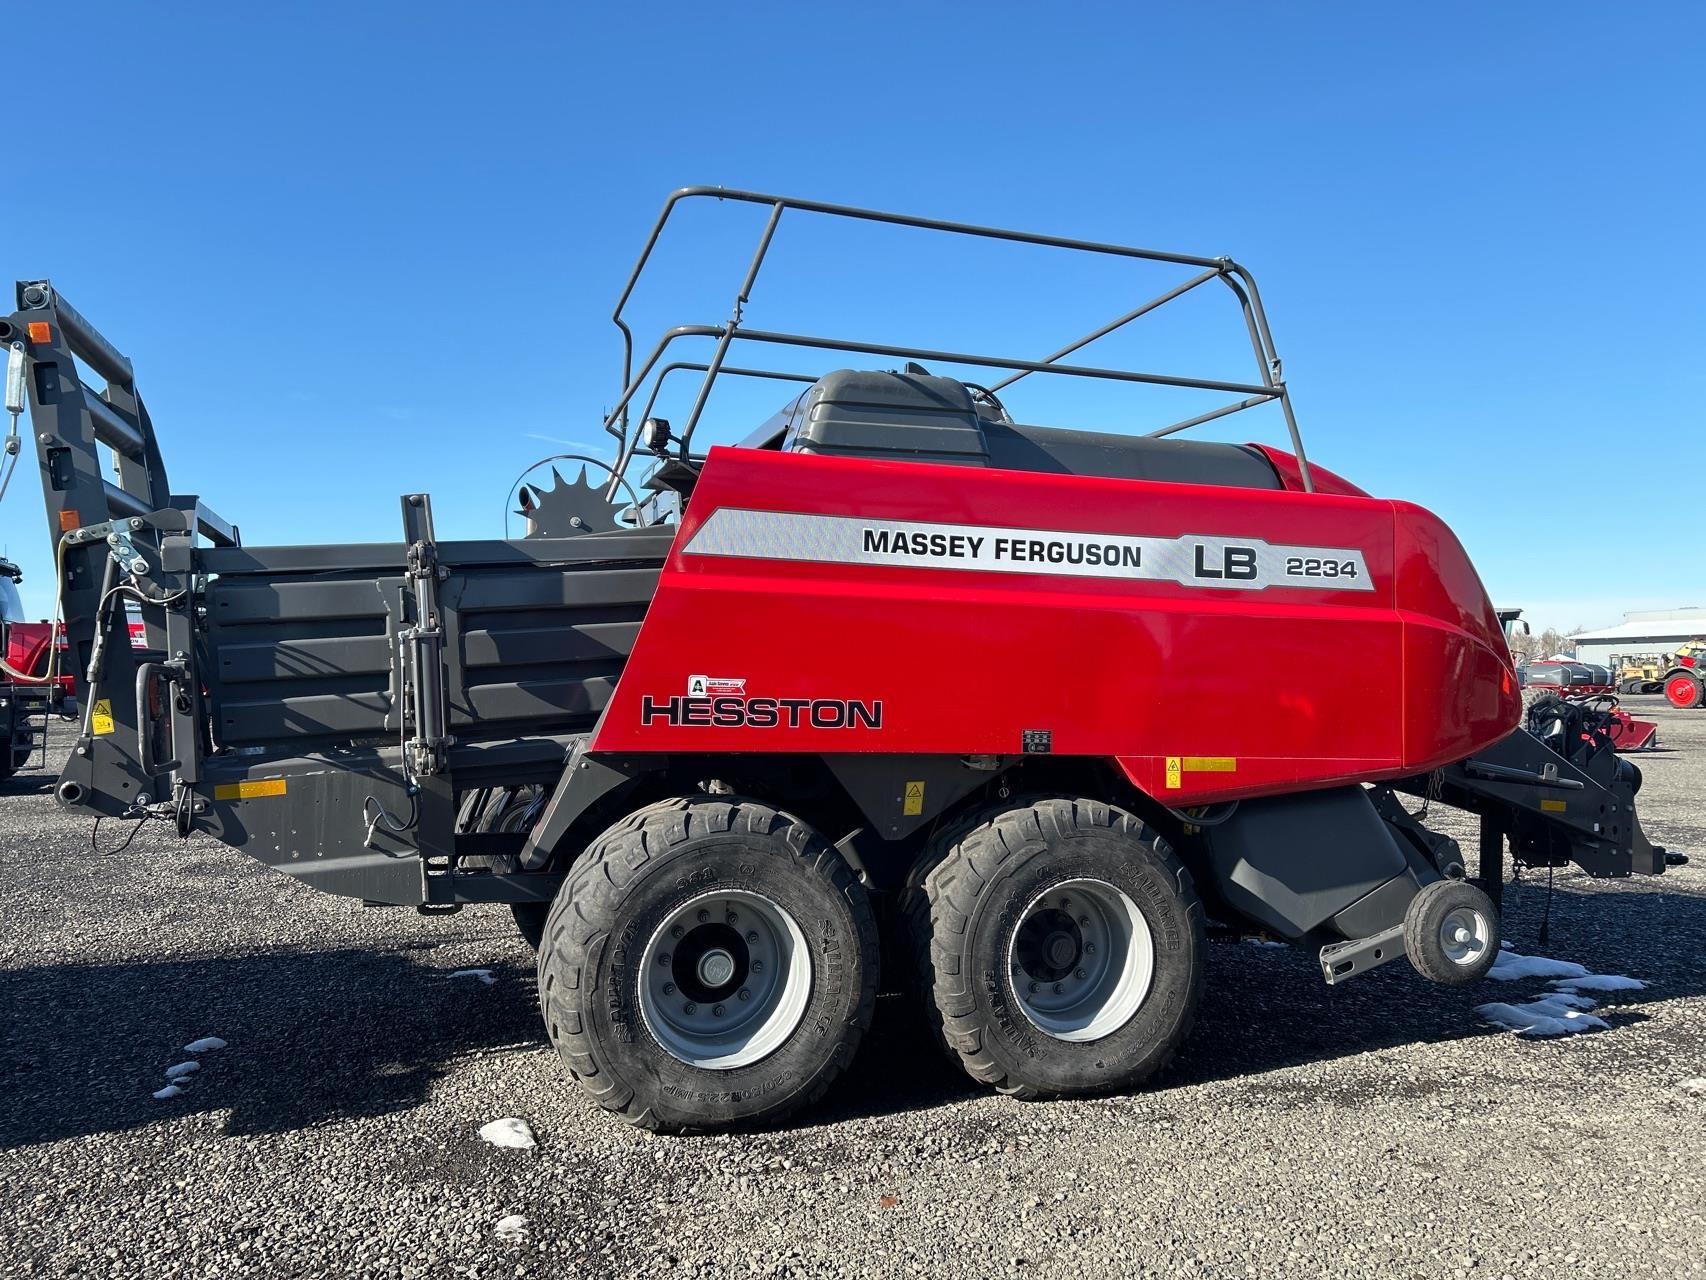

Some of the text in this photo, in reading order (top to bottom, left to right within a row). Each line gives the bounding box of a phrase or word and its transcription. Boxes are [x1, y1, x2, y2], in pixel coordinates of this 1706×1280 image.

[862, 529, 1142, 568] MASSEY FERGUSON
[1194, 544, 1258, 580] LB
[1286, 557, 1358, 579] 2234
[641, 695, 883, 729] HESSTON
